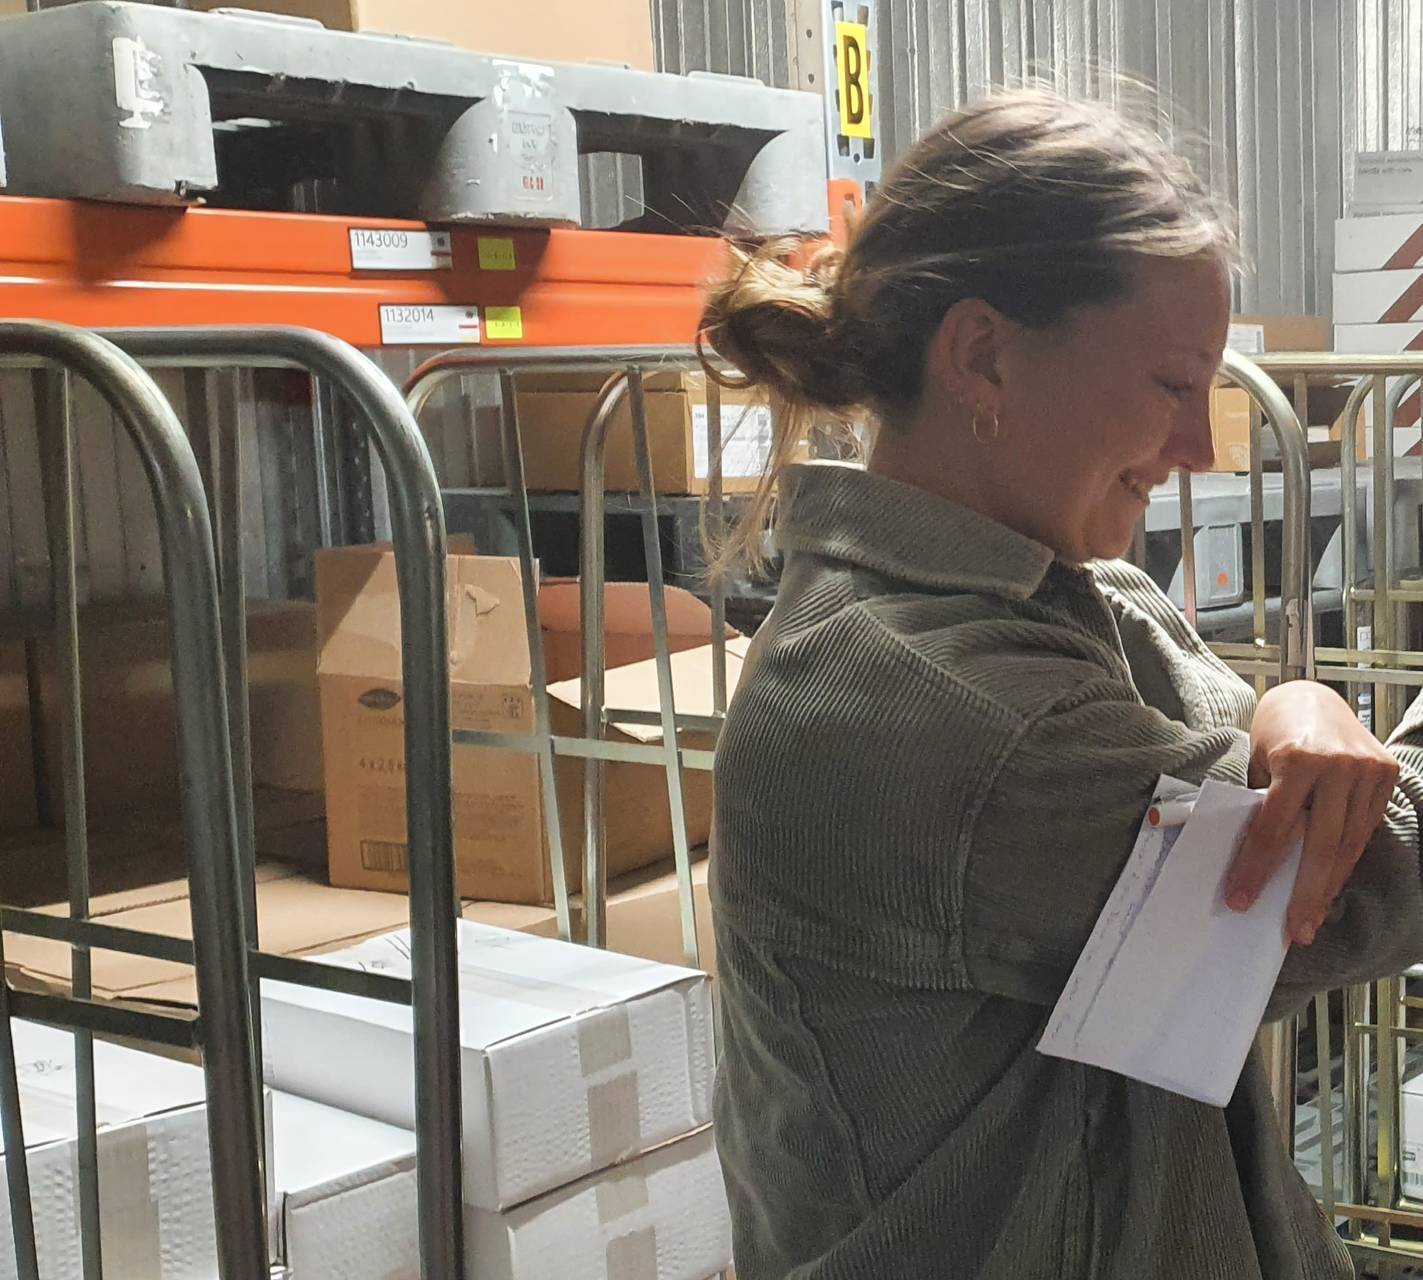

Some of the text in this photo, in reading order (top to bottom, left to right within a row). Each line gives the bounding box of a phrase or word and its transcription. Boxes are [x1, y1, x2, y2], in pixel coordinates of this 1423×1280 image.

[842, 34, 864, 125] B
[354, 231, 408, 249] 1143009
[384, 307, 435, 323] 1132014
